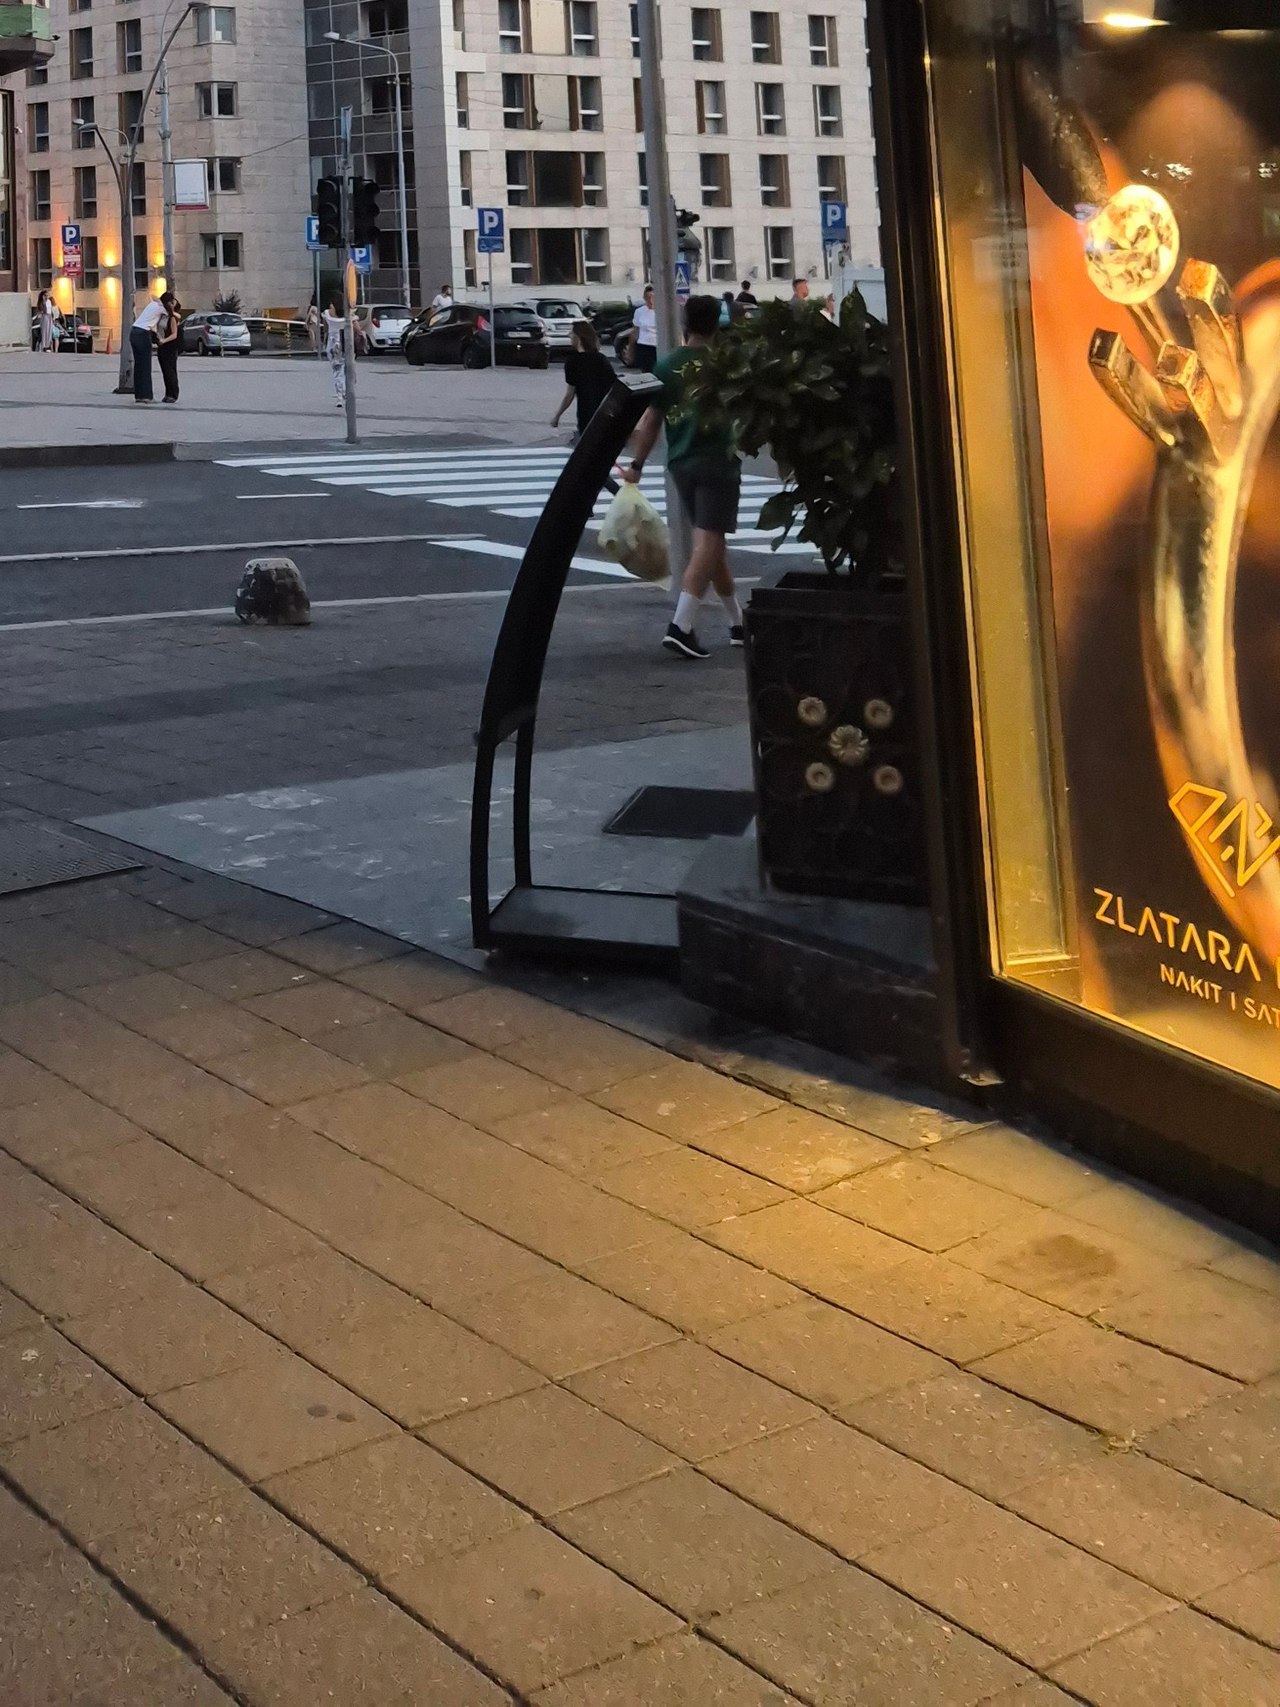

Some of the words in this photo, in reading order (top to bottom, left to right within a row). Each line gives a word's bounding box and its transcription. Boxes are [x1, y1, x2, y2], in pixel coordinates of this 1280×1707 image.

[484, 211, 499, 234] P
[826, 204, 842, 227] P
[65, 226, 77, 243] P
[1093, 887, 1262, 982] ZLATARA
[1159, 962, 1223, 1004] NAKIT
